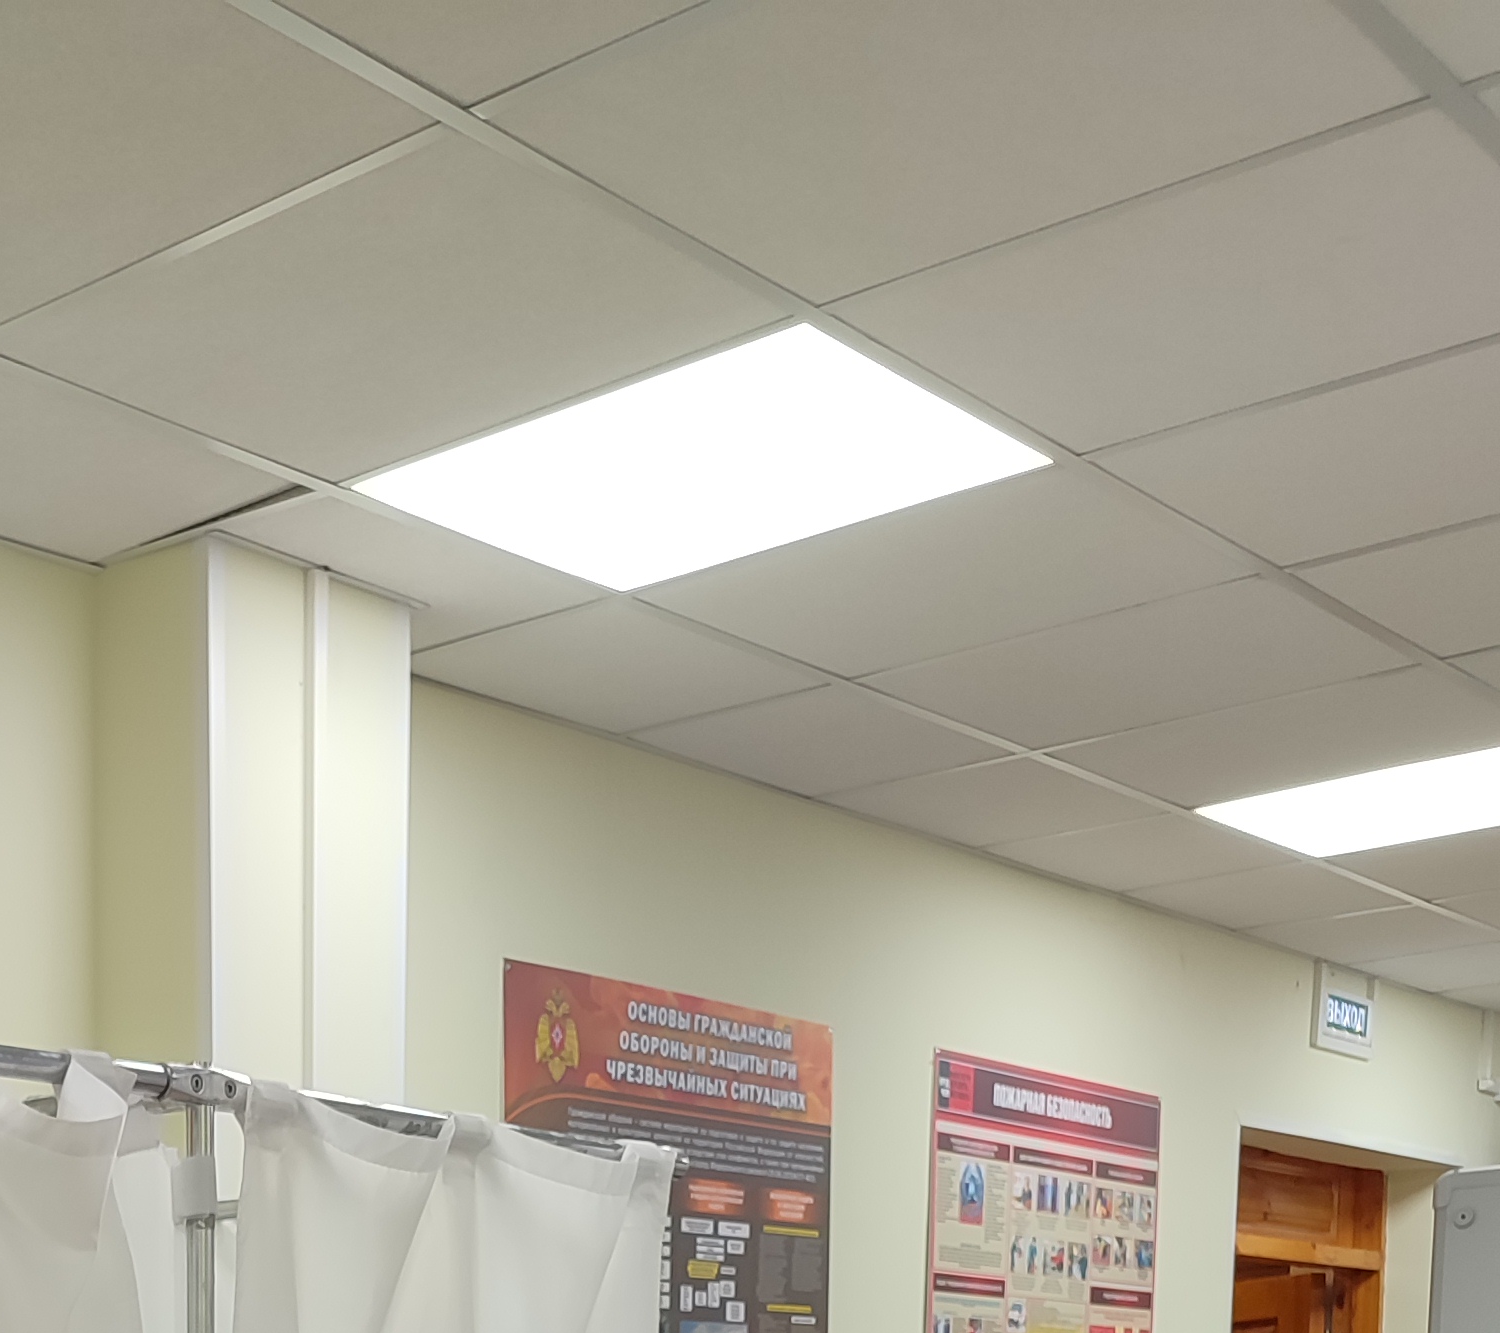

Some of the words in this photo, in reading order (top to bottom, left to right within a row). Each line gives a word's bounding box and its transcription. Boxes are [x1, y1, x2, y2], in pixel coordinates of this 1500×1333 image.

[627, 1001, 691, 1031] ОСНОВЫ
[694, 1014, 793, 1050] ГРАЖДАНСКОЙ
[1327, 998, 1366, 1033] ВЫХОД
[619, 1030, 693, 1062] ОБОРОНЫ
[695, 1046, 706, 1064] И
[708, 1048, 768, 1076] ЗАЩИТЫ
[770, 1059, 798, 1081] ПРИ
[606, 1059, 728, 1098] ЧРЕЗВЫЧАЙНЫХ
[730, 1081, 807, 1112] СИТУАЦИЯХ
[993, 1082, 1046, 1116] ПОЖАРНАЯ
[1046, 1094, 1113, 1130] БЕЗОПАСНОСТЬ
